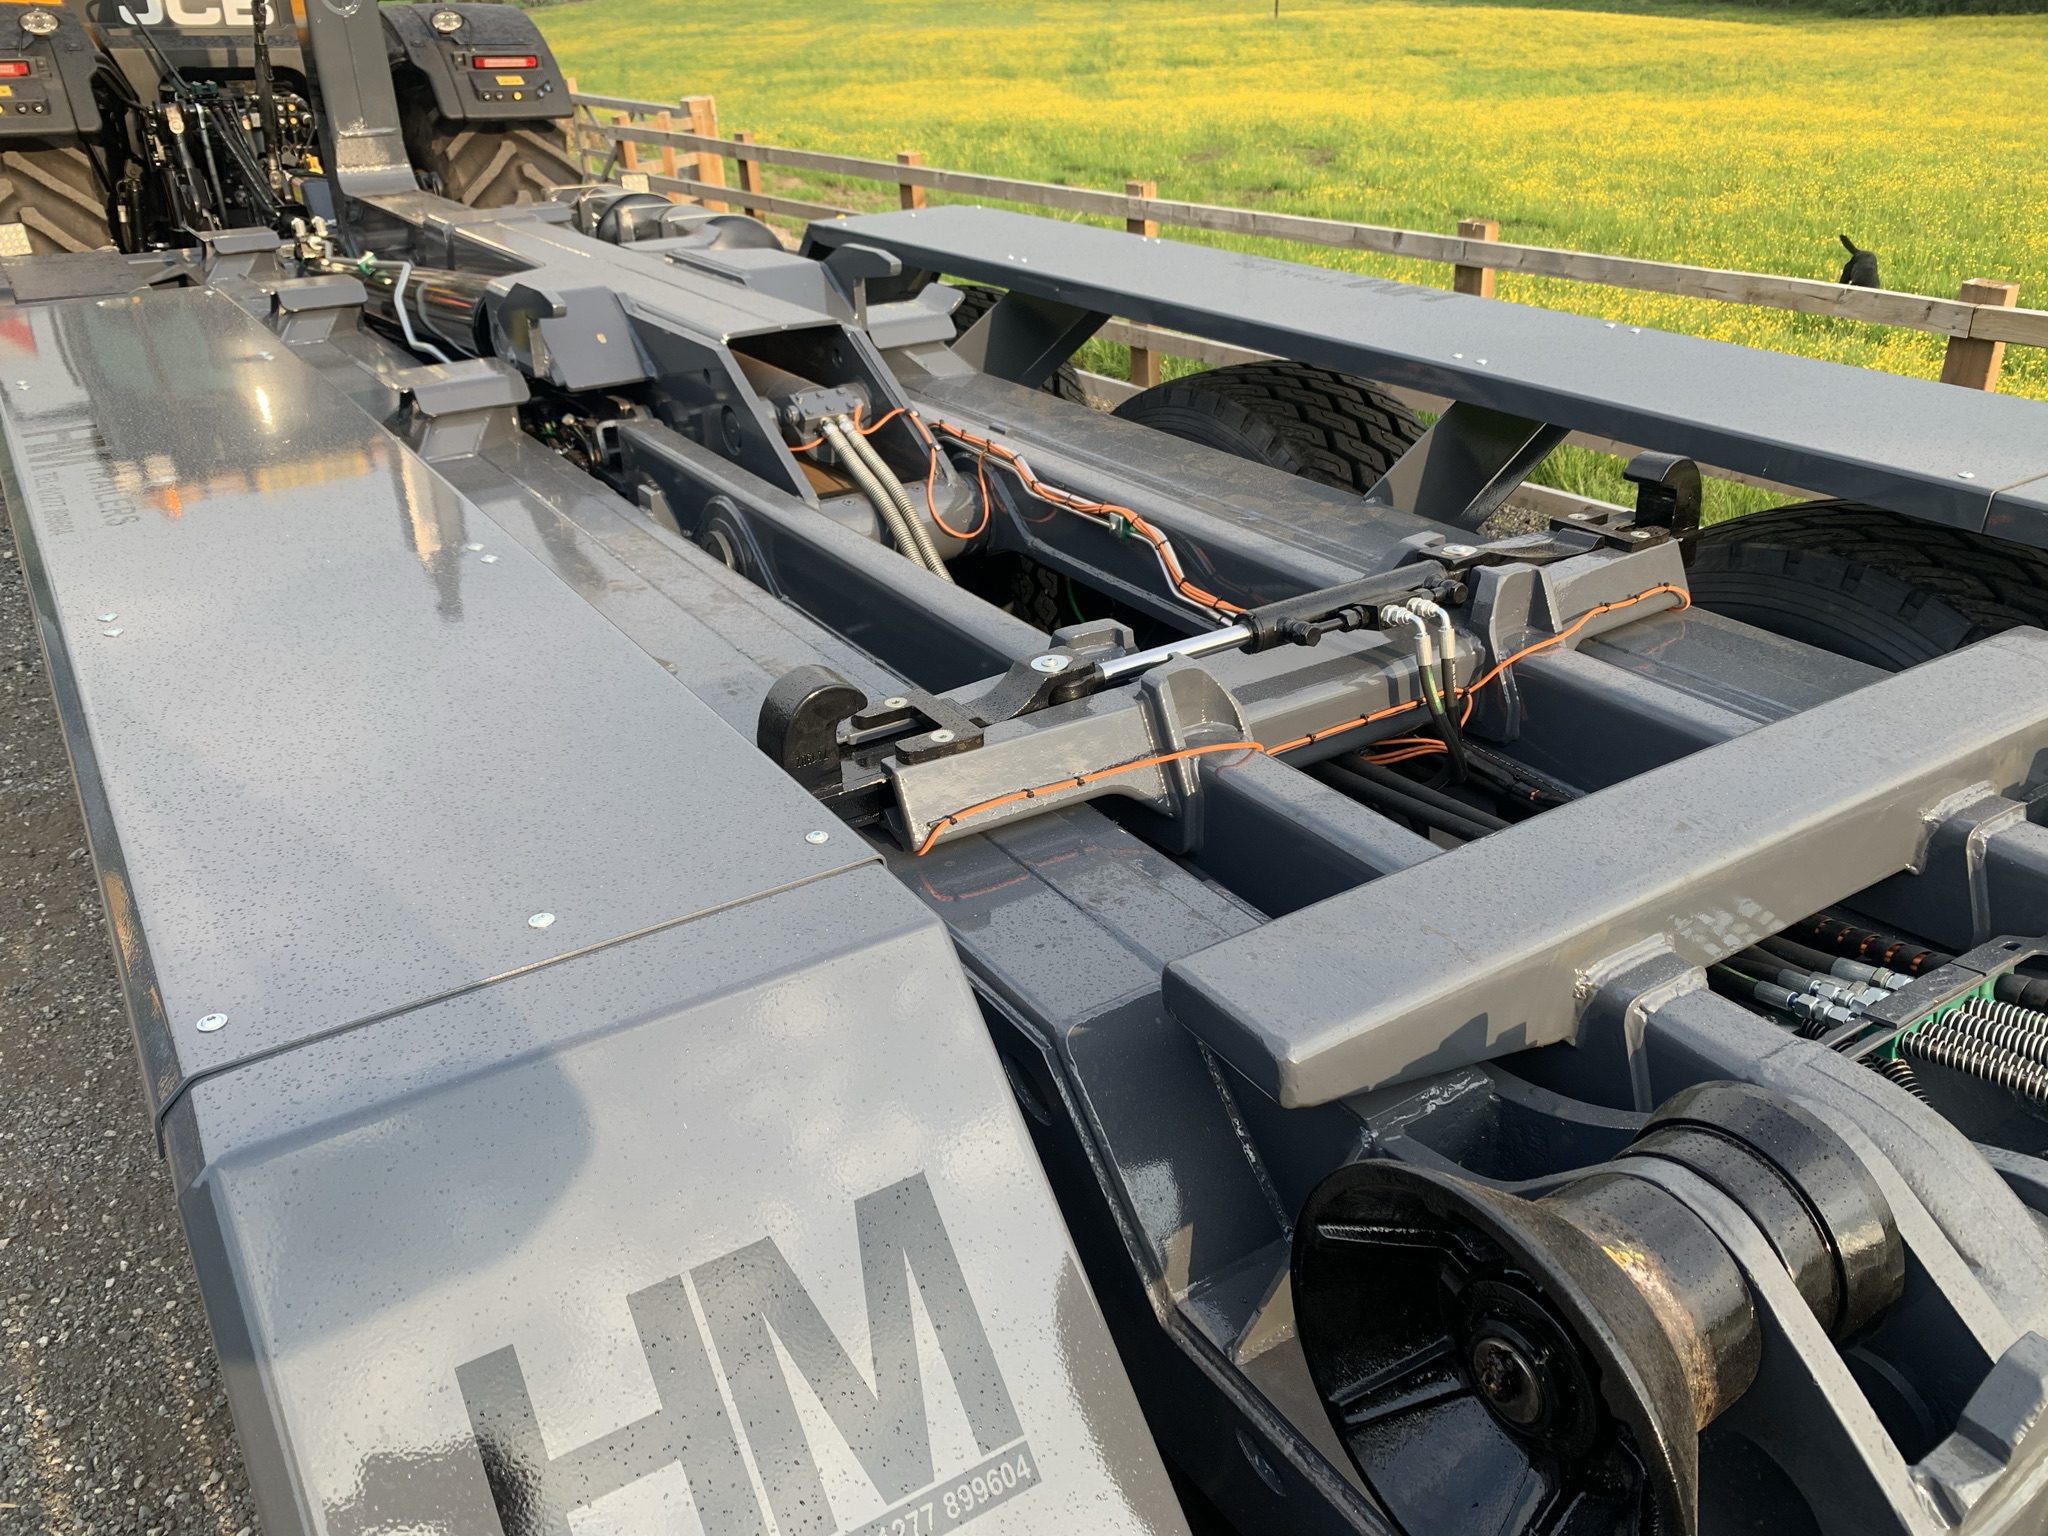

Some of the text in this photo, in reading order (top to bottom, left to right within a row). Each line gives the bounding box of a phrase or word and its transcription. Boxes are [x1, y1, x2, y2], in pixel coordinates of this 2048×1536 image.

[118, 0, 274, 25] JCB
[21, 424, 113, 471] HM
[455, 1171, 1025, 1536] HM
[943, 1454, 1031, 1519] 899604
